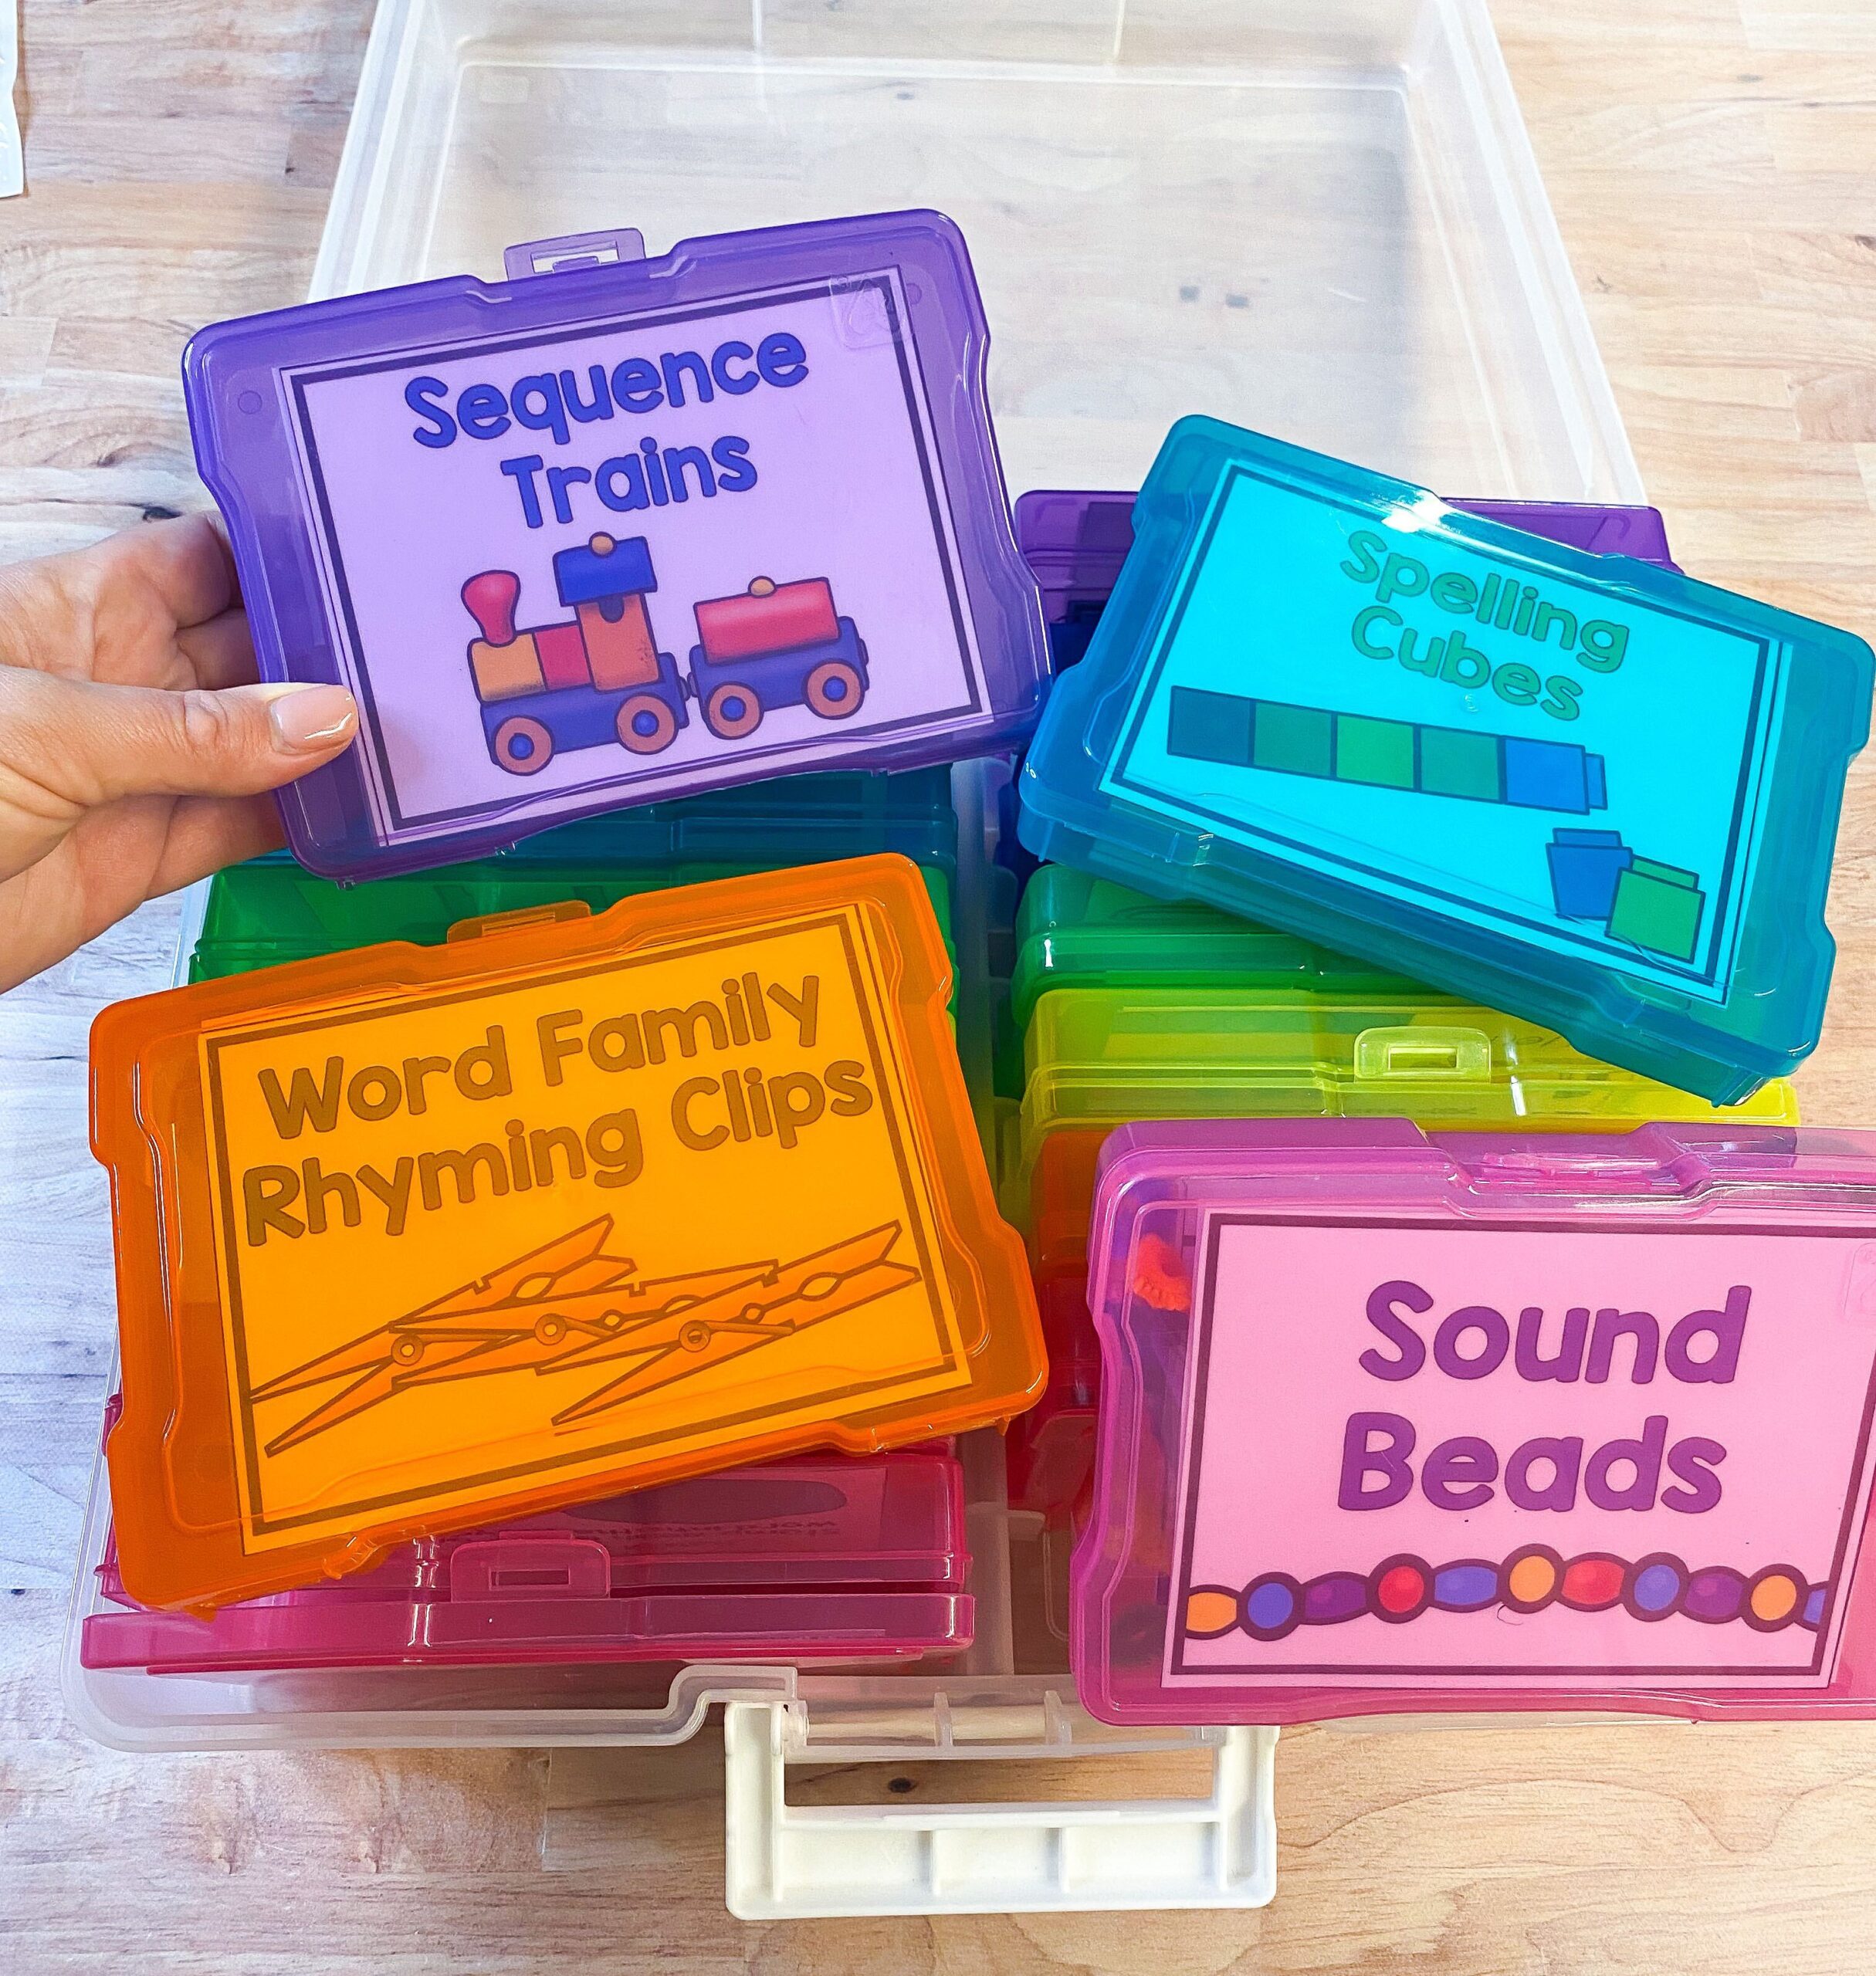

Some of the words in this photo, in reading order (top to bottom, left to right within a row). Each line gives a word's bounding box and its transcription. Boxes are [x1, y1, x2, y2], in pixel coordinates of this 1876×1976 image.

[405, 332, 810, 449] Sequence
[499, 435, 758, 530] Trains
[1340, 530, 1630, 673] Spelling
[1351, 604, 1583, 722] Cubes
[258, 1024, 513, 1140] Word
[537, 972, 820, 1088] Family
[242, 1108, 644, 1247] Rhyming
[671, 1059, 874, 1152] Clips
[1358, 1280, 1752, 1385] Sound
[1337, 1411, 1728, 1514] Beads
